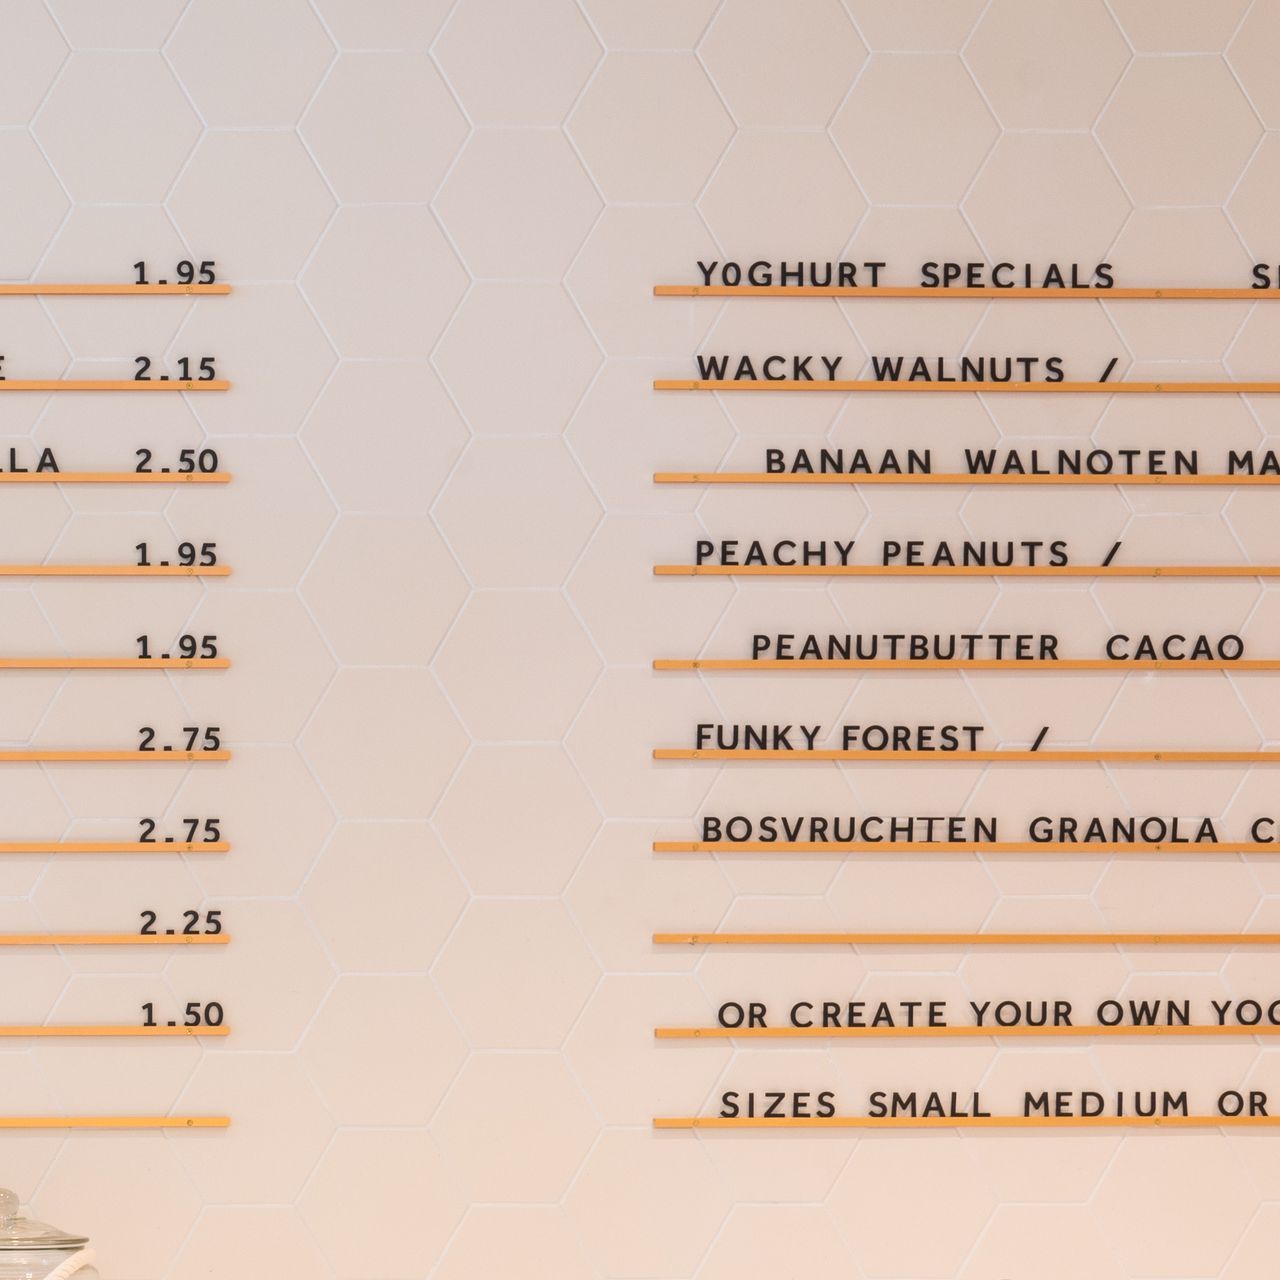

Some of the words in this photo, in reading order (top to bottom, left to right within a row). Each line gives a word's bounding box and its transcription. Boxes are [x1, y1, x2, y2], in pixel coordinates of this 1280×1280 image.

[133, 260, 217, 285] 1.95
[920, 261, 1115, 289] SPECIALS
[1251, 263, 1280, 290] S
[134, 356, 217, 381] 2.15
[696, 355, 844, 382] WACKY
[871, 356, 1065, 383] WALNUTS
[135, 448, 219, 474] 2.50
[766, 448, 931, 475] BANAAN
[964, 448, 1199, 476] WALNOTEN
[135, 541, 218, 567] 1.95
[696, 540, 855, 567] PEACHY
[882, 540, 1070, 567] PEANUTS
[136, 634, 219, 660] 1.95
[752, 634, 1060, 661] PEANUTBUTTER
[1105, 634, 1245, 661] CACAO
[138, 726, 222, 752] 2.75
[696, 723, 822, 751] FUNKY
[842, 724, 985, 752] FOREST
[139, 818, 222, 844] 2.75
[1028, 816, 1219, 844] GRANOLA
[140, 910, 223, 936] 2.25
[141, 1001, 225, 1027] 1.50
[717, 1001, 769, 1029] OR
[790, 1001, 948, 1029] CREATE
[969, 1000, 1074, 1028] YOUR
[1096, 999, 1191, 1027] OWN
[719, 1091, 837, 1119] SIZES
[868, 1091, 992, 1119] SMALL
[1023, 1091, 1189, 1118] MEDIUM
[1217, 1090, 1269, 1118] OR
